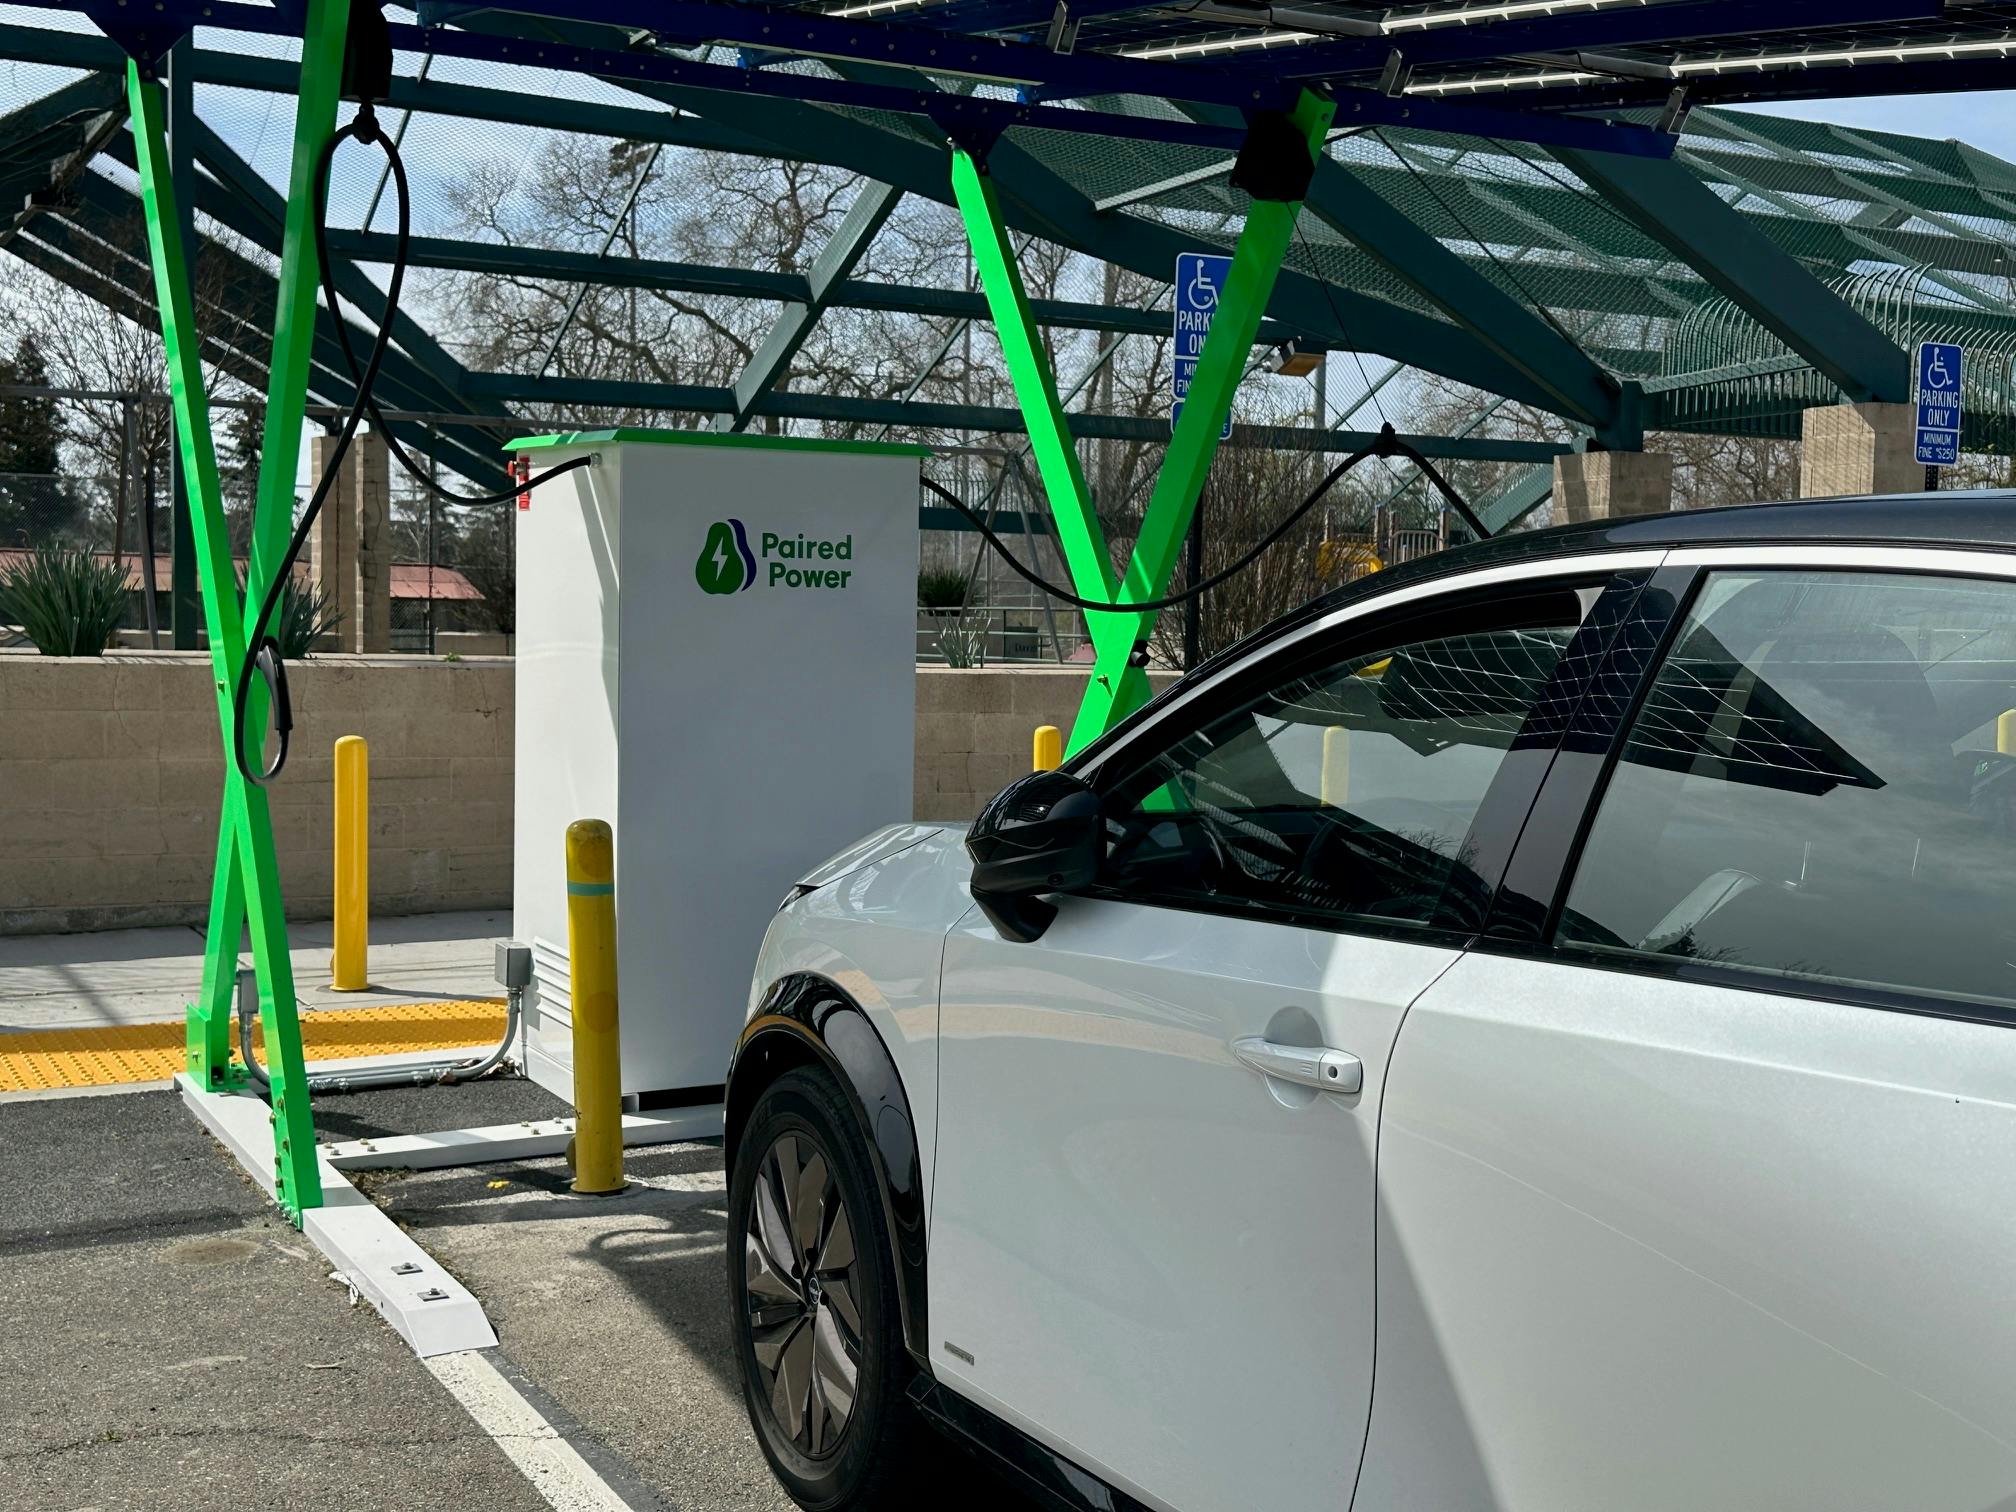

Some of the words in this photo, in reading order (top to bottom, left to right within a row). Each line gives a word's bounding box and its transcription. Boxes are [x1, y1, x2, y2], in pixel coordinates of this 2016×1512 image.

[1178, 309, 1214, 332] PARK
[1189, 333, 1206, 354] ON
[1176, 379, 1192, 393] FIN
[1920, 388, 1959, 409] PARKING
[1927, 408, 1950, 427] ONLY
[1923, 432, 1952, 446] MINIMUM
[1918, 446, 1933, 459] FINE
[761, 532, 852, 560] Paired
[769, 562, 852, 588] Power
